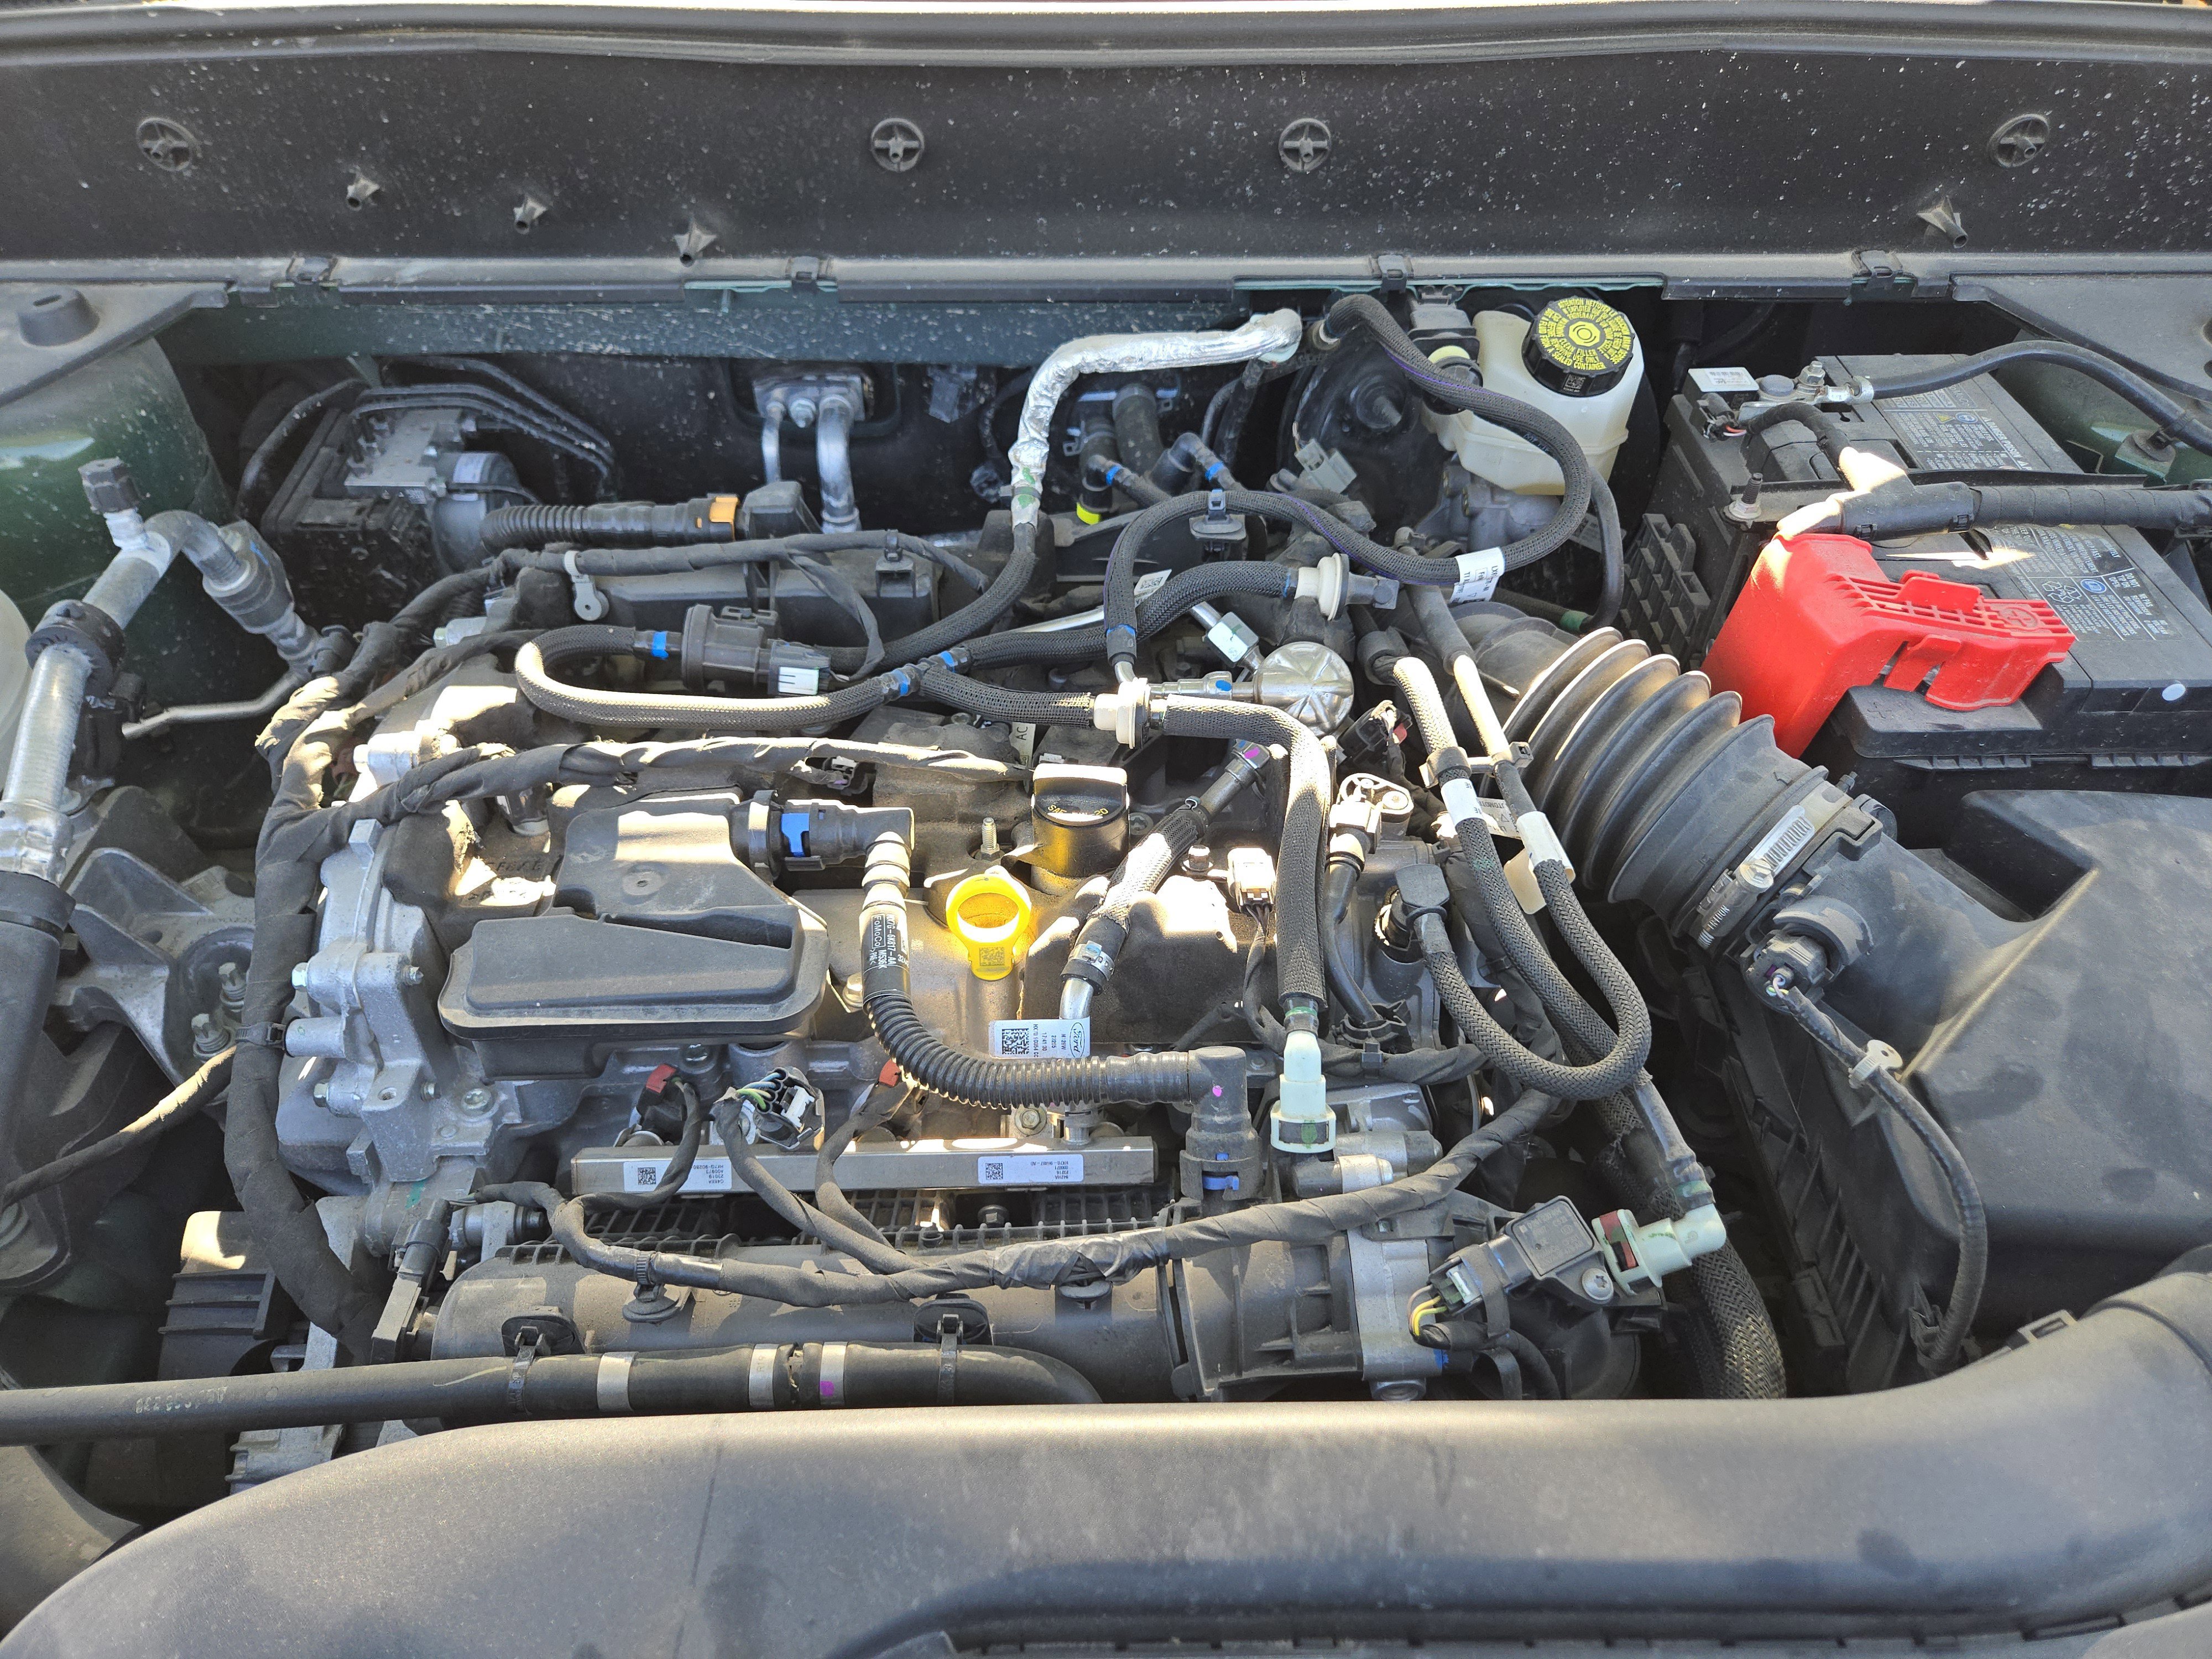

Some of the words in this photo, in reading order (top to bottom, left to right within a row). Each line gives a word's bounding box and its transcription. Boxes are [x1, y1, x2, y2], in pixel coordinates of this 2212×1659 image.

[1552, 352, 1573, 366] SEALED
[2129, 579, 2140, 587] NOT
[1016, 727, 1027, 740] AC
